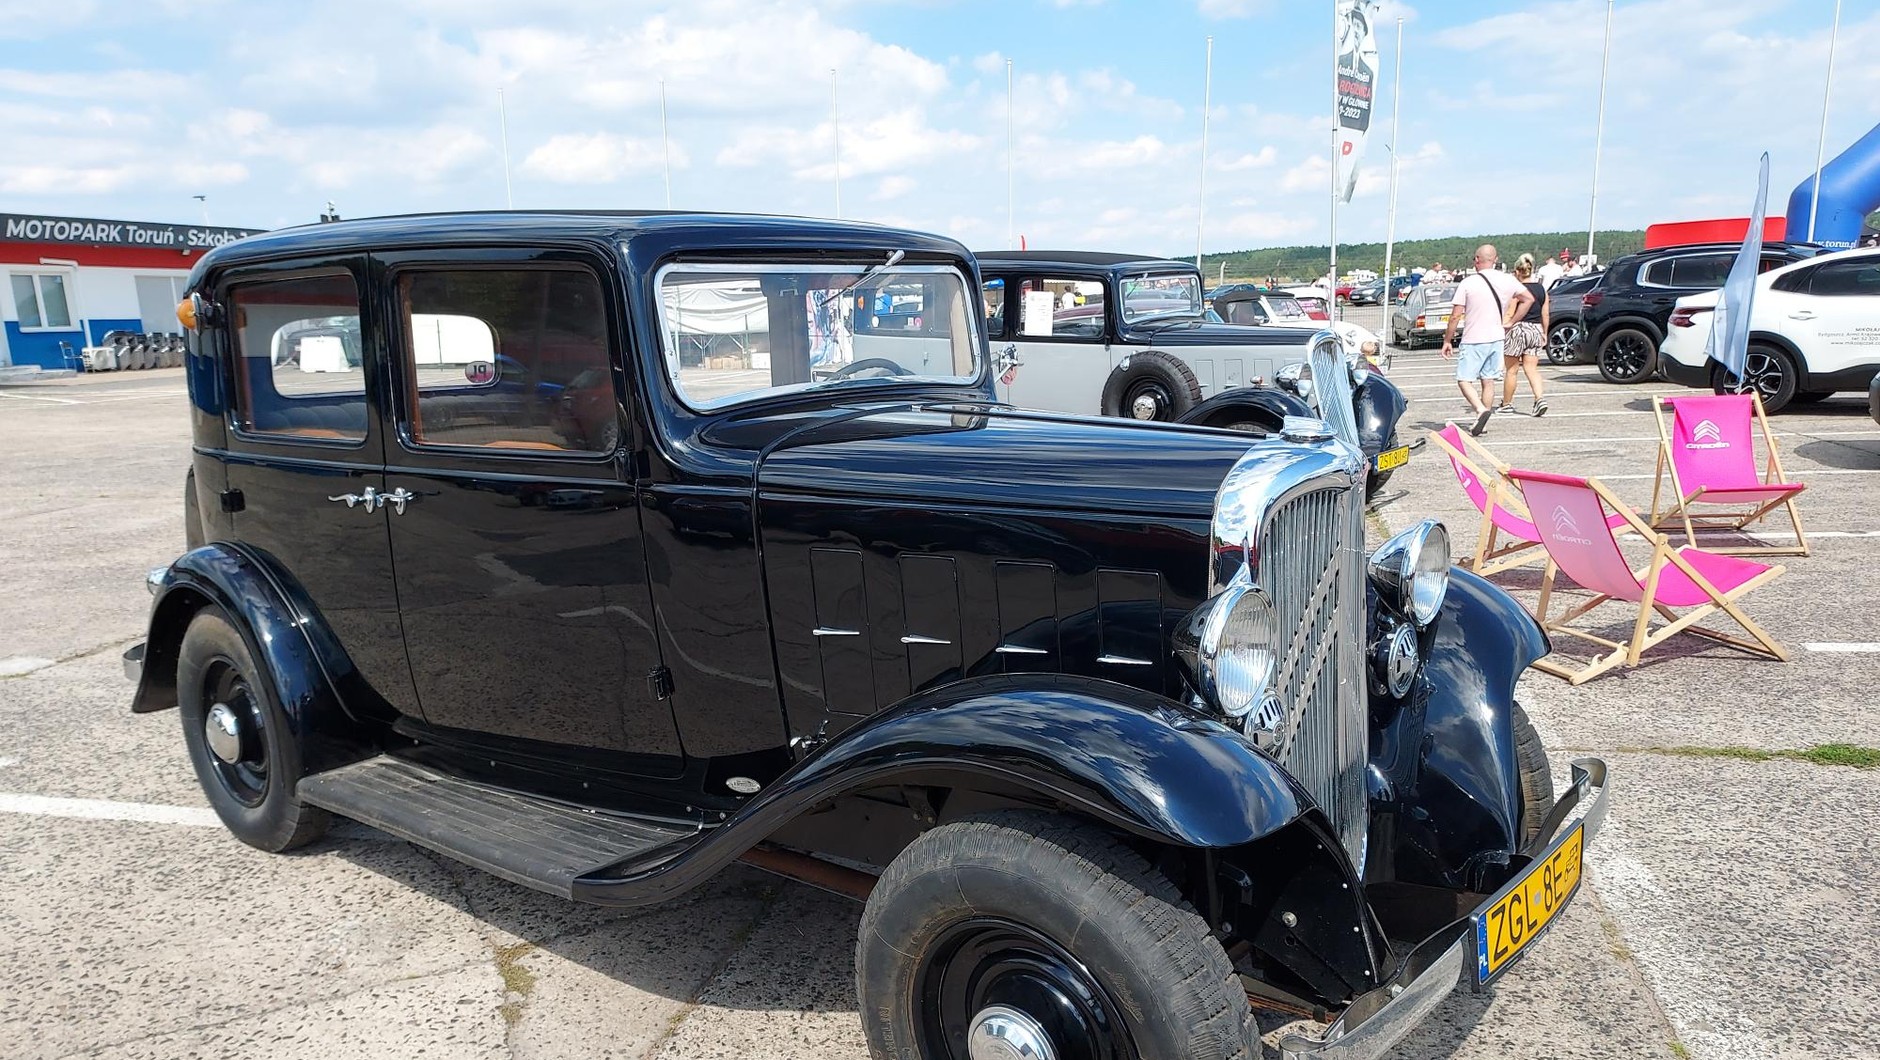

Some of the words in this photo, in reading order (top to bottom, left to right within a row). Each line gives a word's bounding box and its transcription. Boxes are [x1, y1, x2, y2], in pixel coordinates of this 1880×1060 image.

[6, 219, 122, 242] MOTOPARK
[126, 225, 174, 244] Toruń
[1491, 884, 1538, 964] ZGL
[1543, 851, 1563, 913] 8E
[1479, 953, 1488, 970] PL
